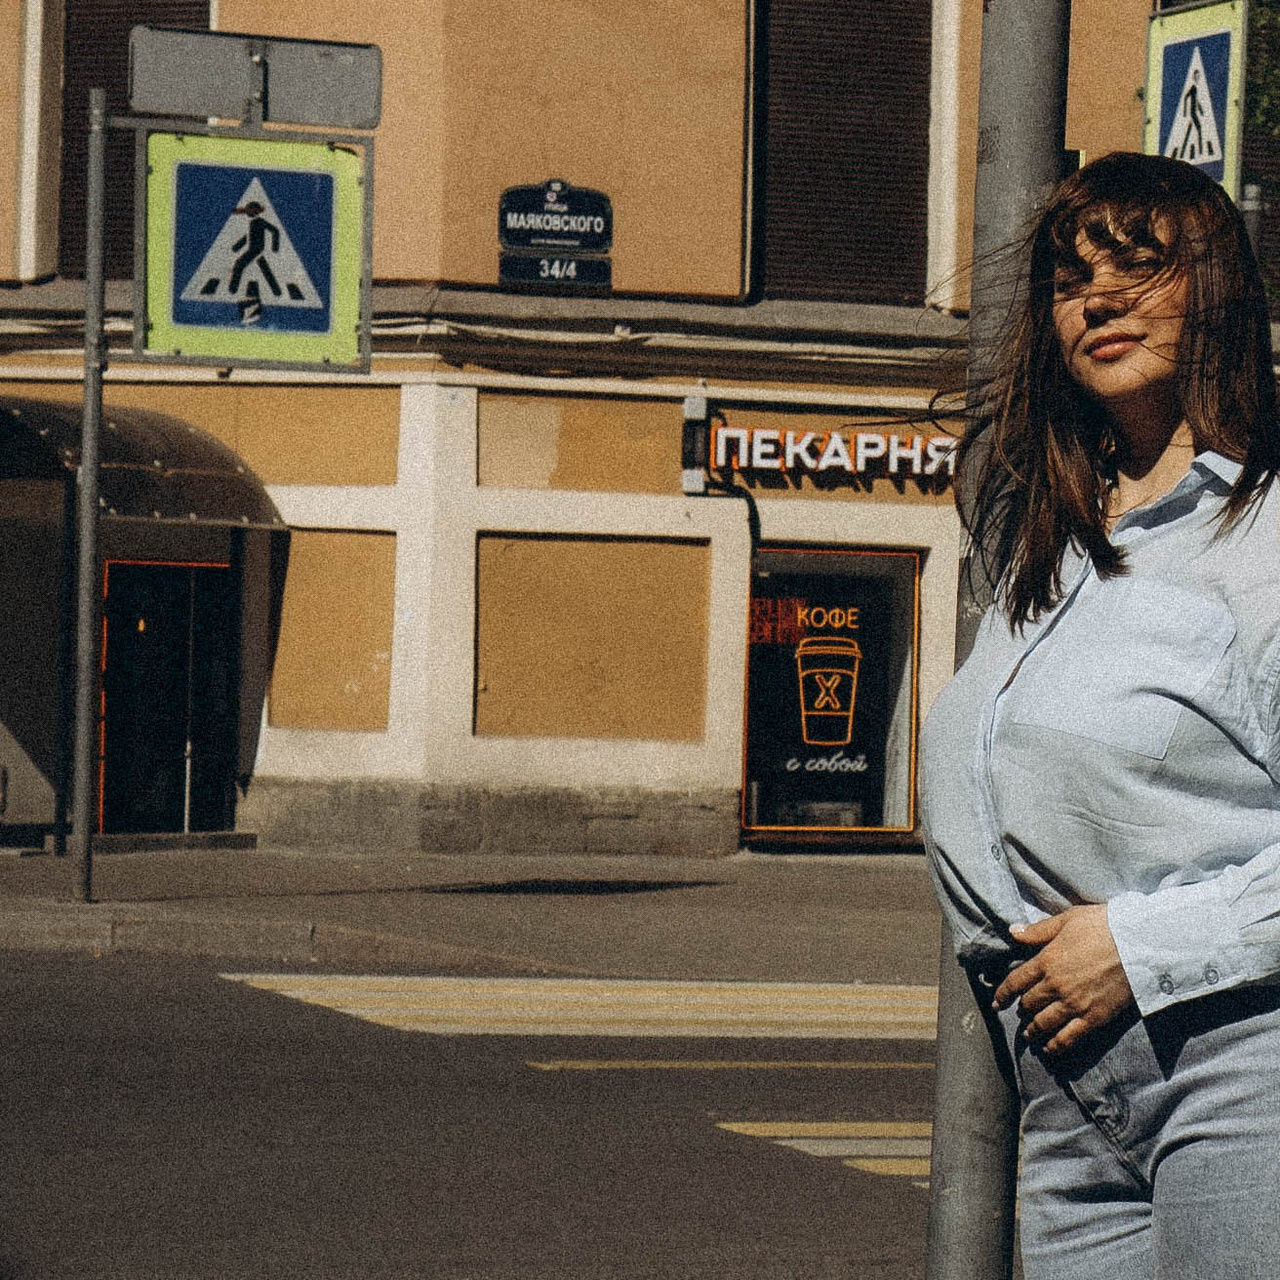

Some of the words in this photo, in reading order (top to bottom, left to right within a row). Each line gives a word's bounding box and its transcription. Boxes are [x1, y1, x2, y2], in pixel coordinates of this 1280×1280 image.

[506, 211, 604, 233] МАЯКОВСКОГО
[539, 258, 577, 279] 34/4
[715, 427, 957, 476] ПЕКАРНЯ
[797, 606, 860, 629] КОФЕ
[804, 750, 869, 773] собой
